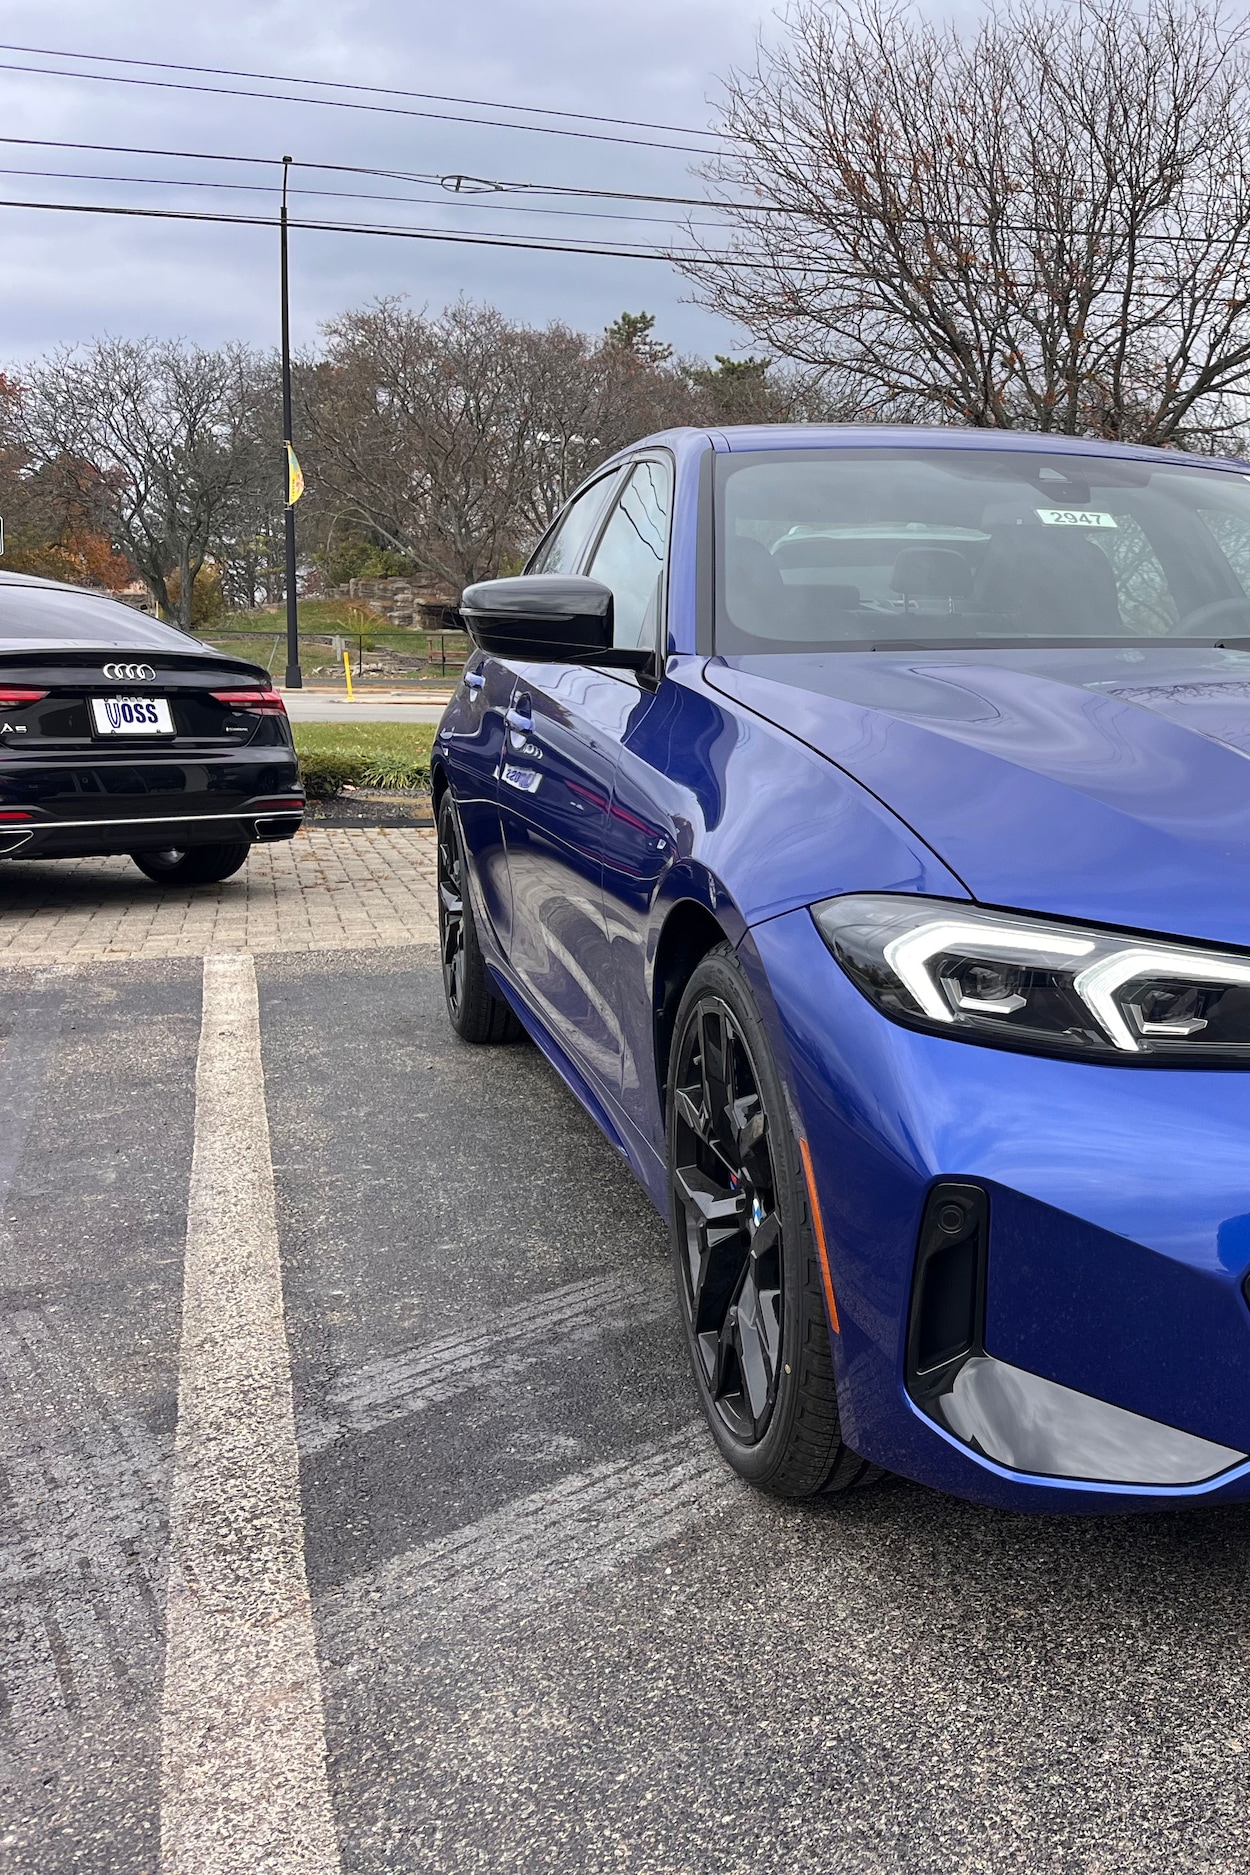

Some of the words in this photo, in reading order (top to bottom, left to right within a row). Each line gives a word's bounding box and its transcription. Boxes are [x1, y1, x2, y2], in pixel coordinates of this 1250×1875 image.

[1050, 511, 1102, 525] 2947
[105, 702, 159, 728] VOSS
[0, 723, 28, 734] A5
